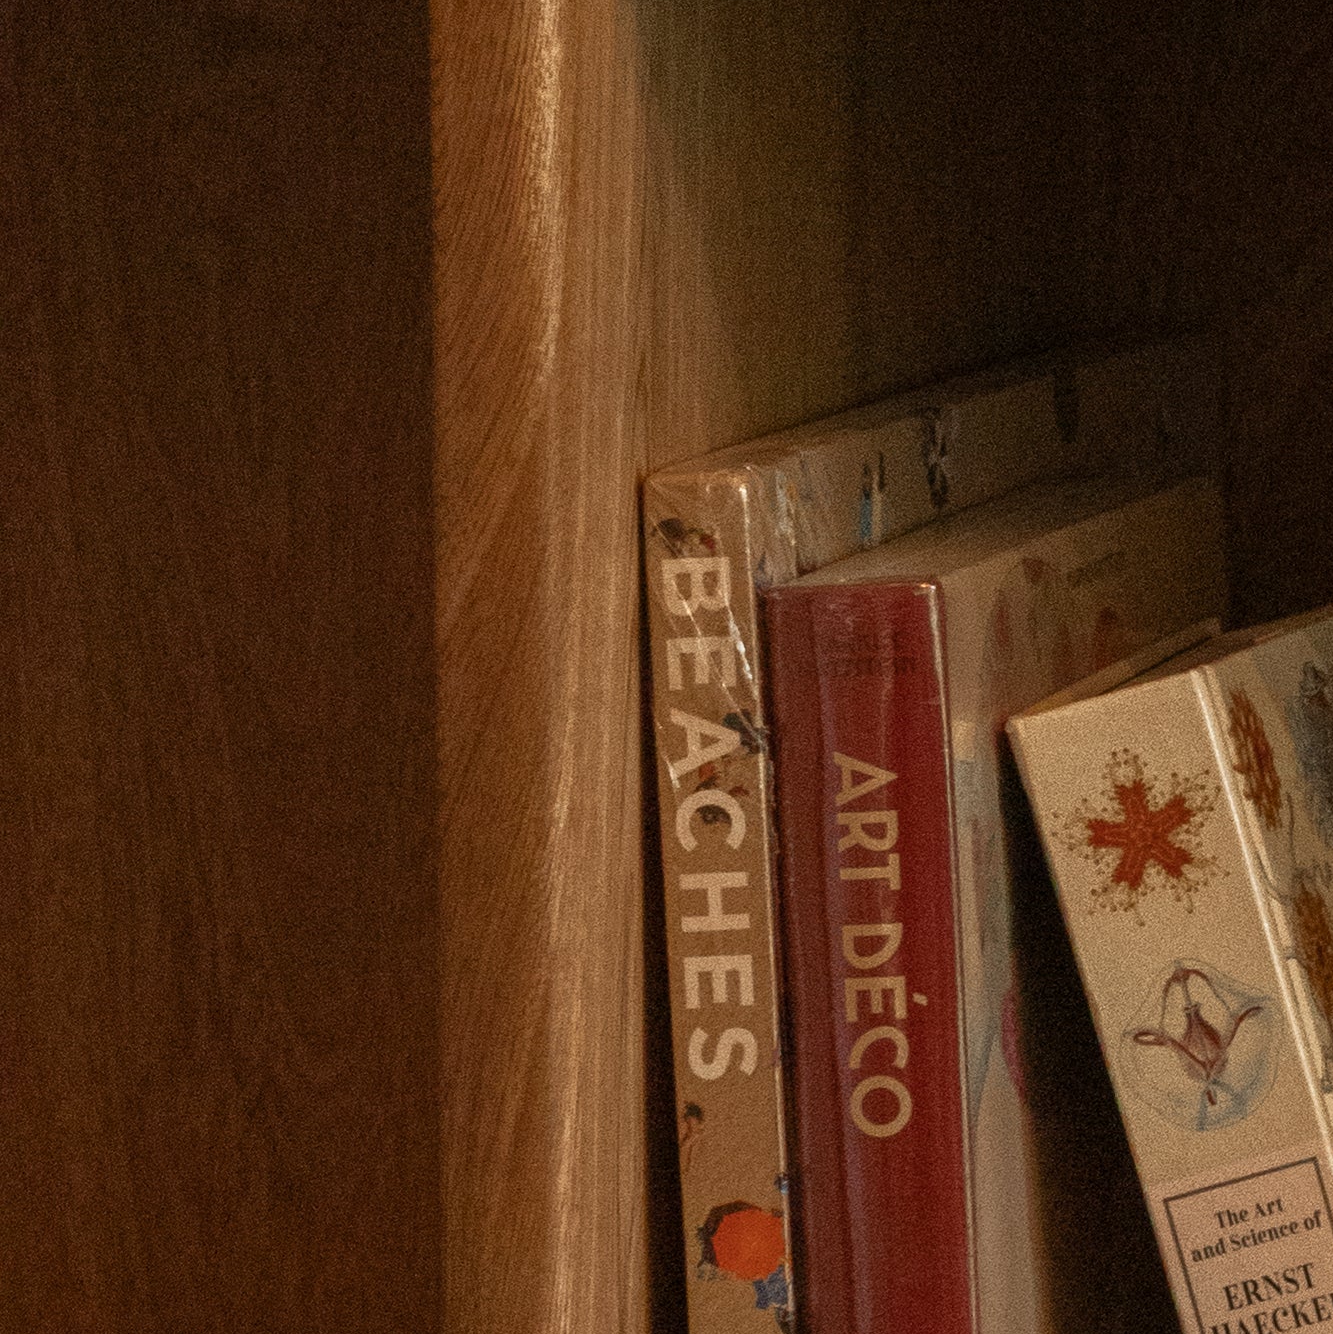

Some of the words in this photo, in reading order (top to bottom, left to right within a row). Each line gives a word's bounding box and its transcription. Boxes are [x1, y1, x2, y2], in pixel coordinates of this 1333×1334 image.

[660, 556, 759, 1081] BEACHES
[833, 751, 900, 893] ART
[841, 924, 929, 1138] DÉCO
[1191, 1236, 1227, 1262] and
[1229, 1219, 1300, 1249] Science
[1303, 1208, 1323, 1231] of
[1214, 1208, 1248, 1229] The
[1254, 1197, 1284, 1220] Art
[1222, 1263, 1317, 1311] ERNST
